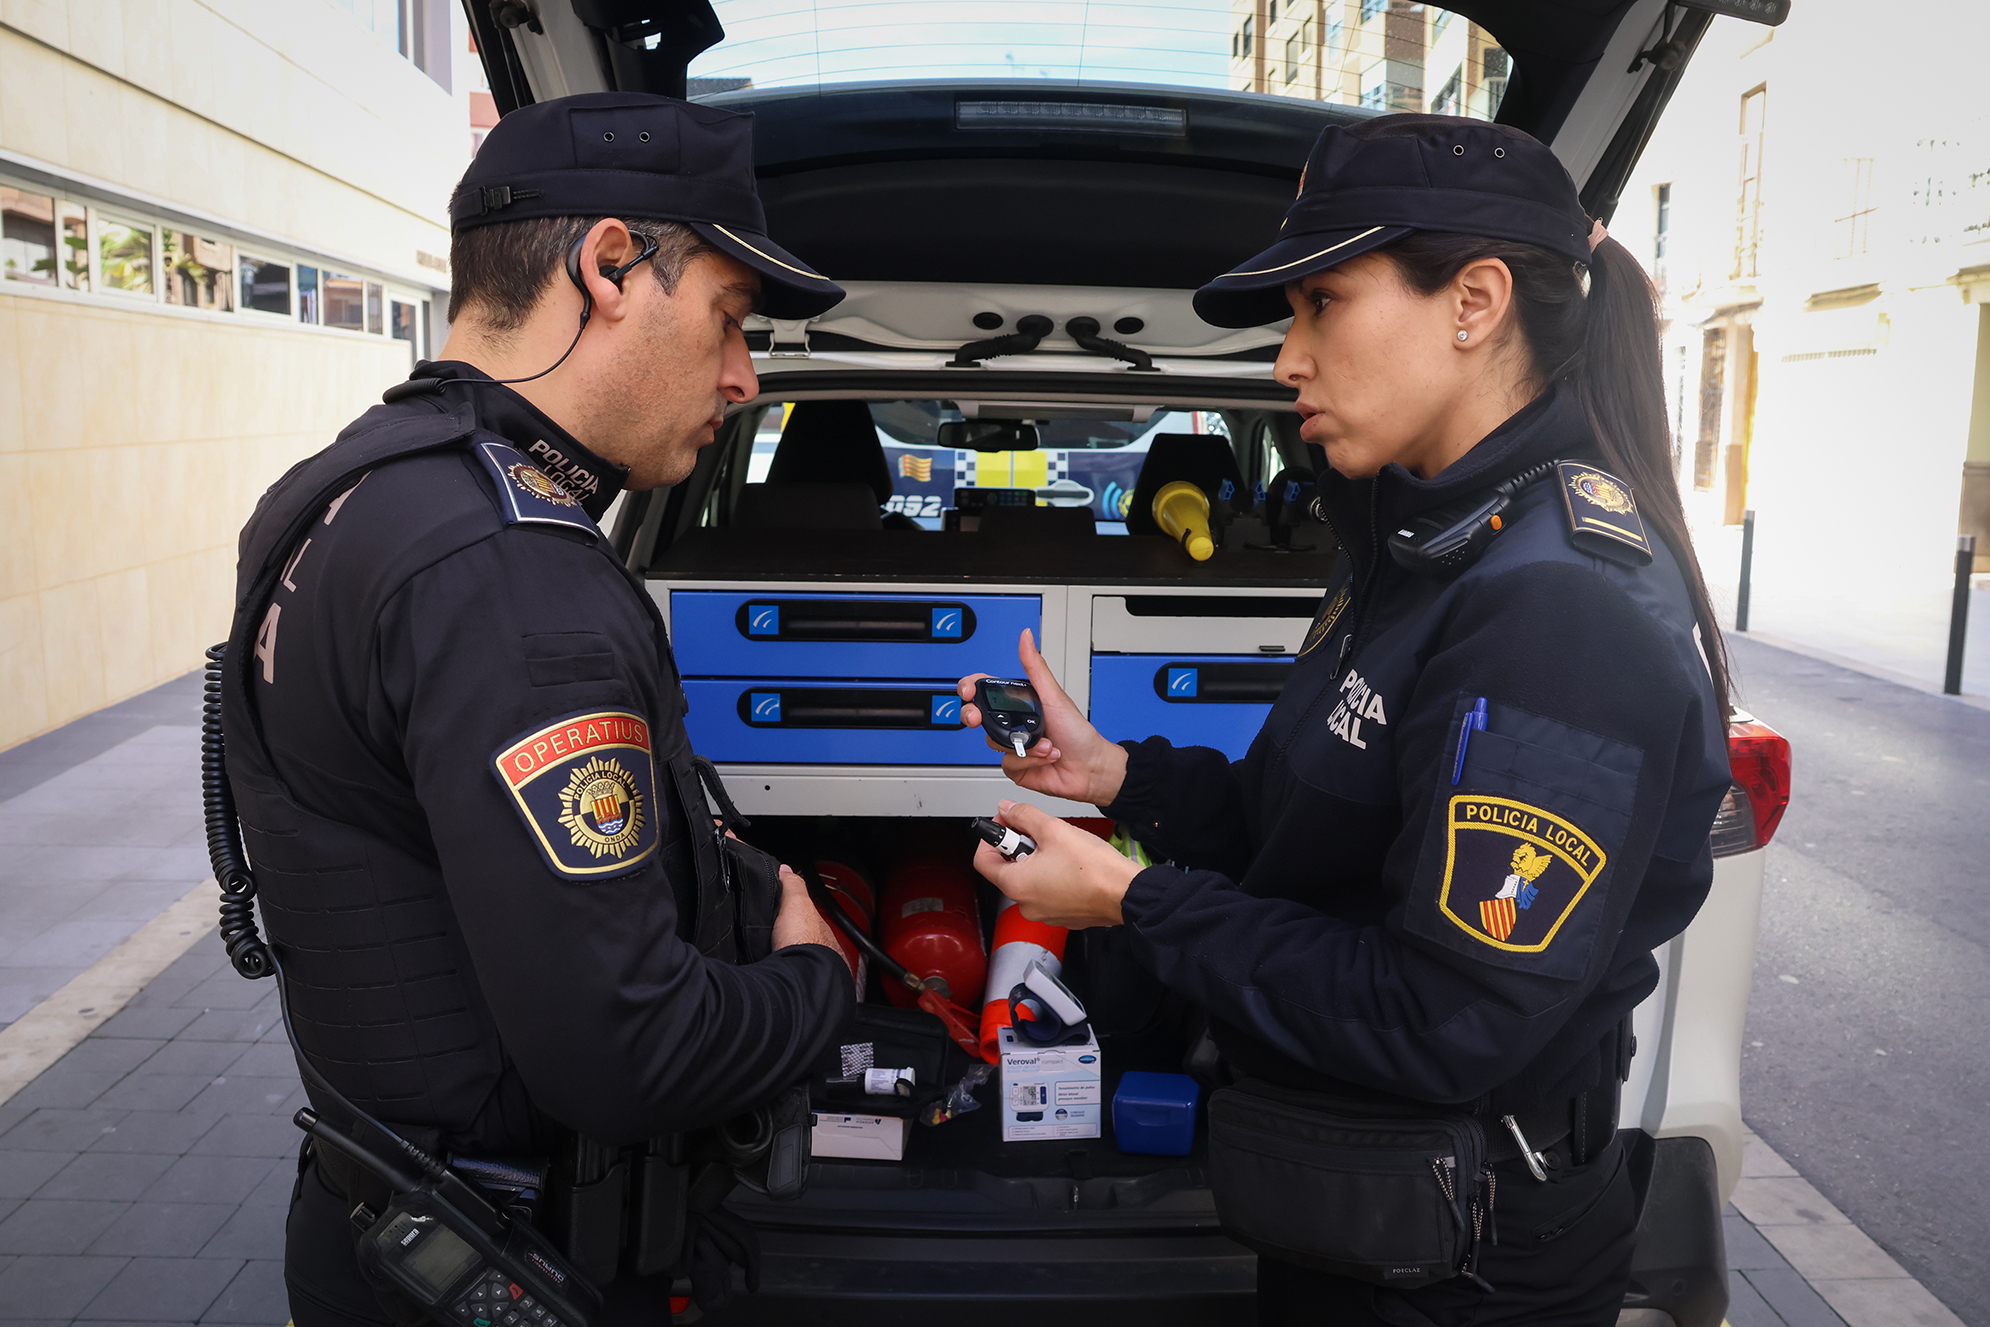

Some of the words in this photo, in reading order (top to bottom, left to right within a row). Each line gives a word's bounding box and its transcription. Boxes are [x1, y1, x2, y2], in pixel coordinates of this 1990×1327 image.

[528, 439, 599, 495] POLICIA
[886, 494, 942, 517] 092
[1339, 668, 1387, 725] POCIA
[514, 721, 644, 773] OPERATIUS
[1327, 699, 1367, 750] LCAL
[573, 771, 600, 801] POLICIA
[601, 771, 626, 788] LOCAL
[604, 832, 626, 843] ONDA
[1466, 804, 1539, 833] POLICIA
[1545, 824, 1592, 866] LOCAL
